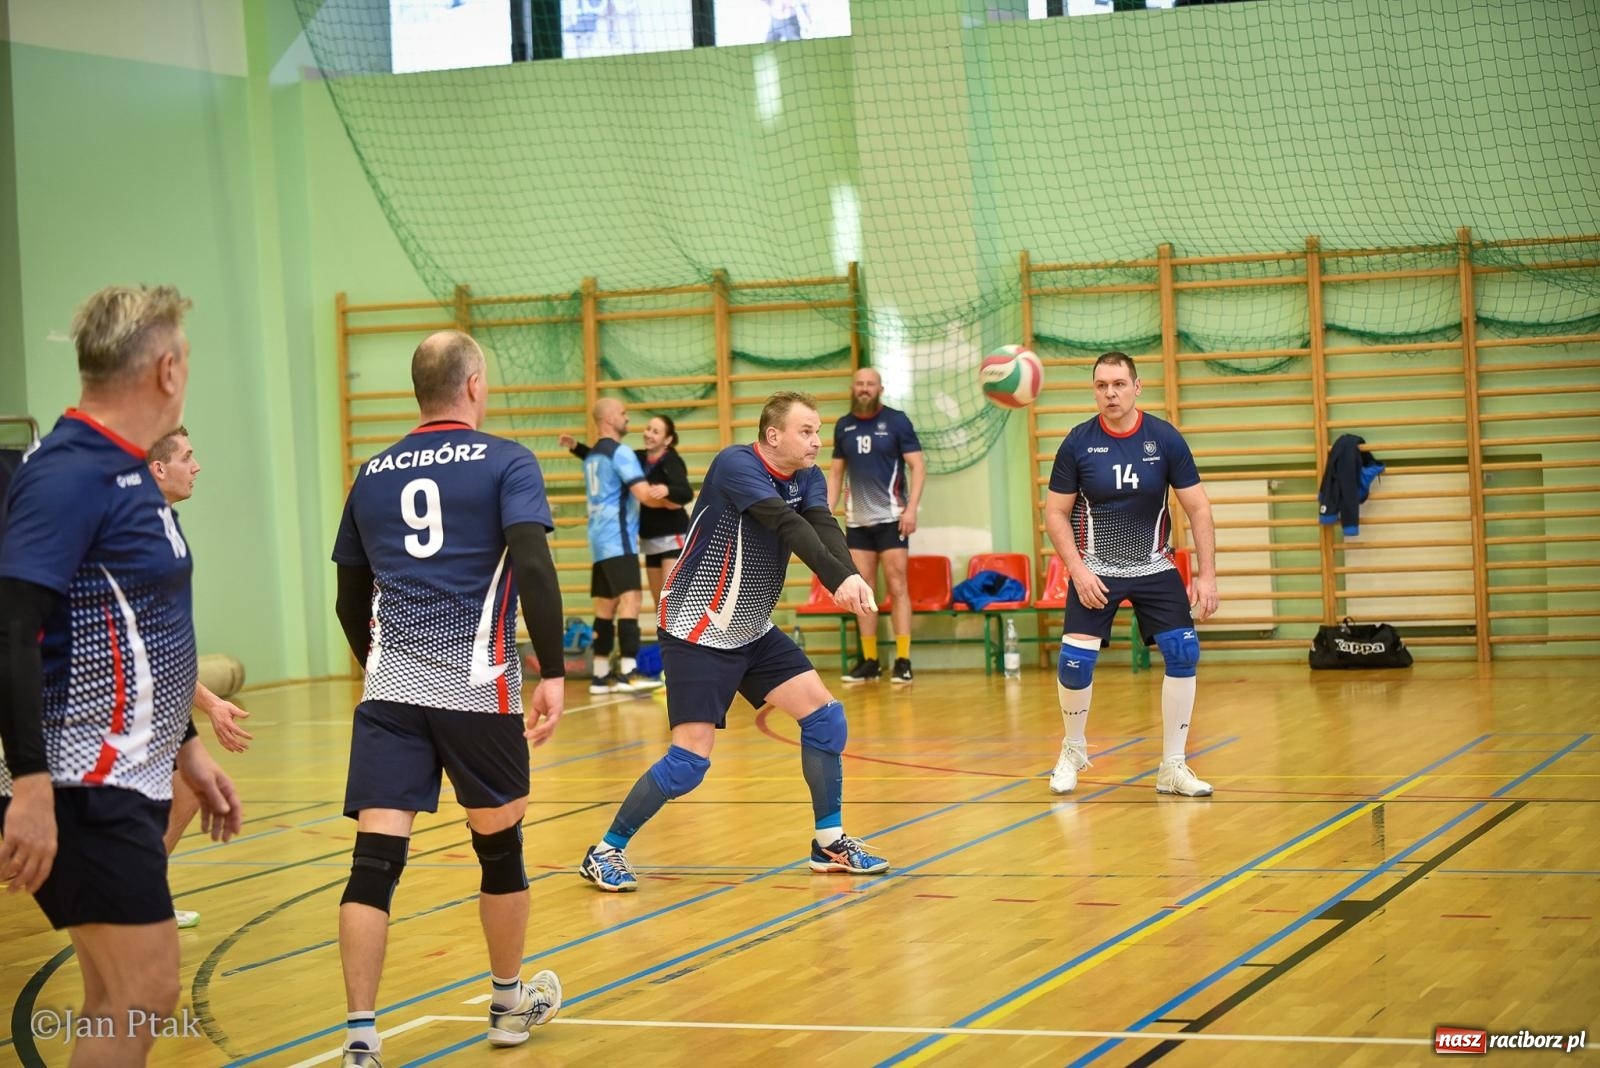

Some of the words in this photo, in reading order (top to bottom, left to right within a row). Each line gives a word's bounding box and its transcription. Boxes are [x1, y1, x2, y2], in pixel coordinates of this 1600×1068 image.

[365, 442, 488, 476] RACIBÓRZ
[856, 435, 871, 454] 19
[1112, 464, 1139, 489] 14
[401, 478, 444, 558] 9
